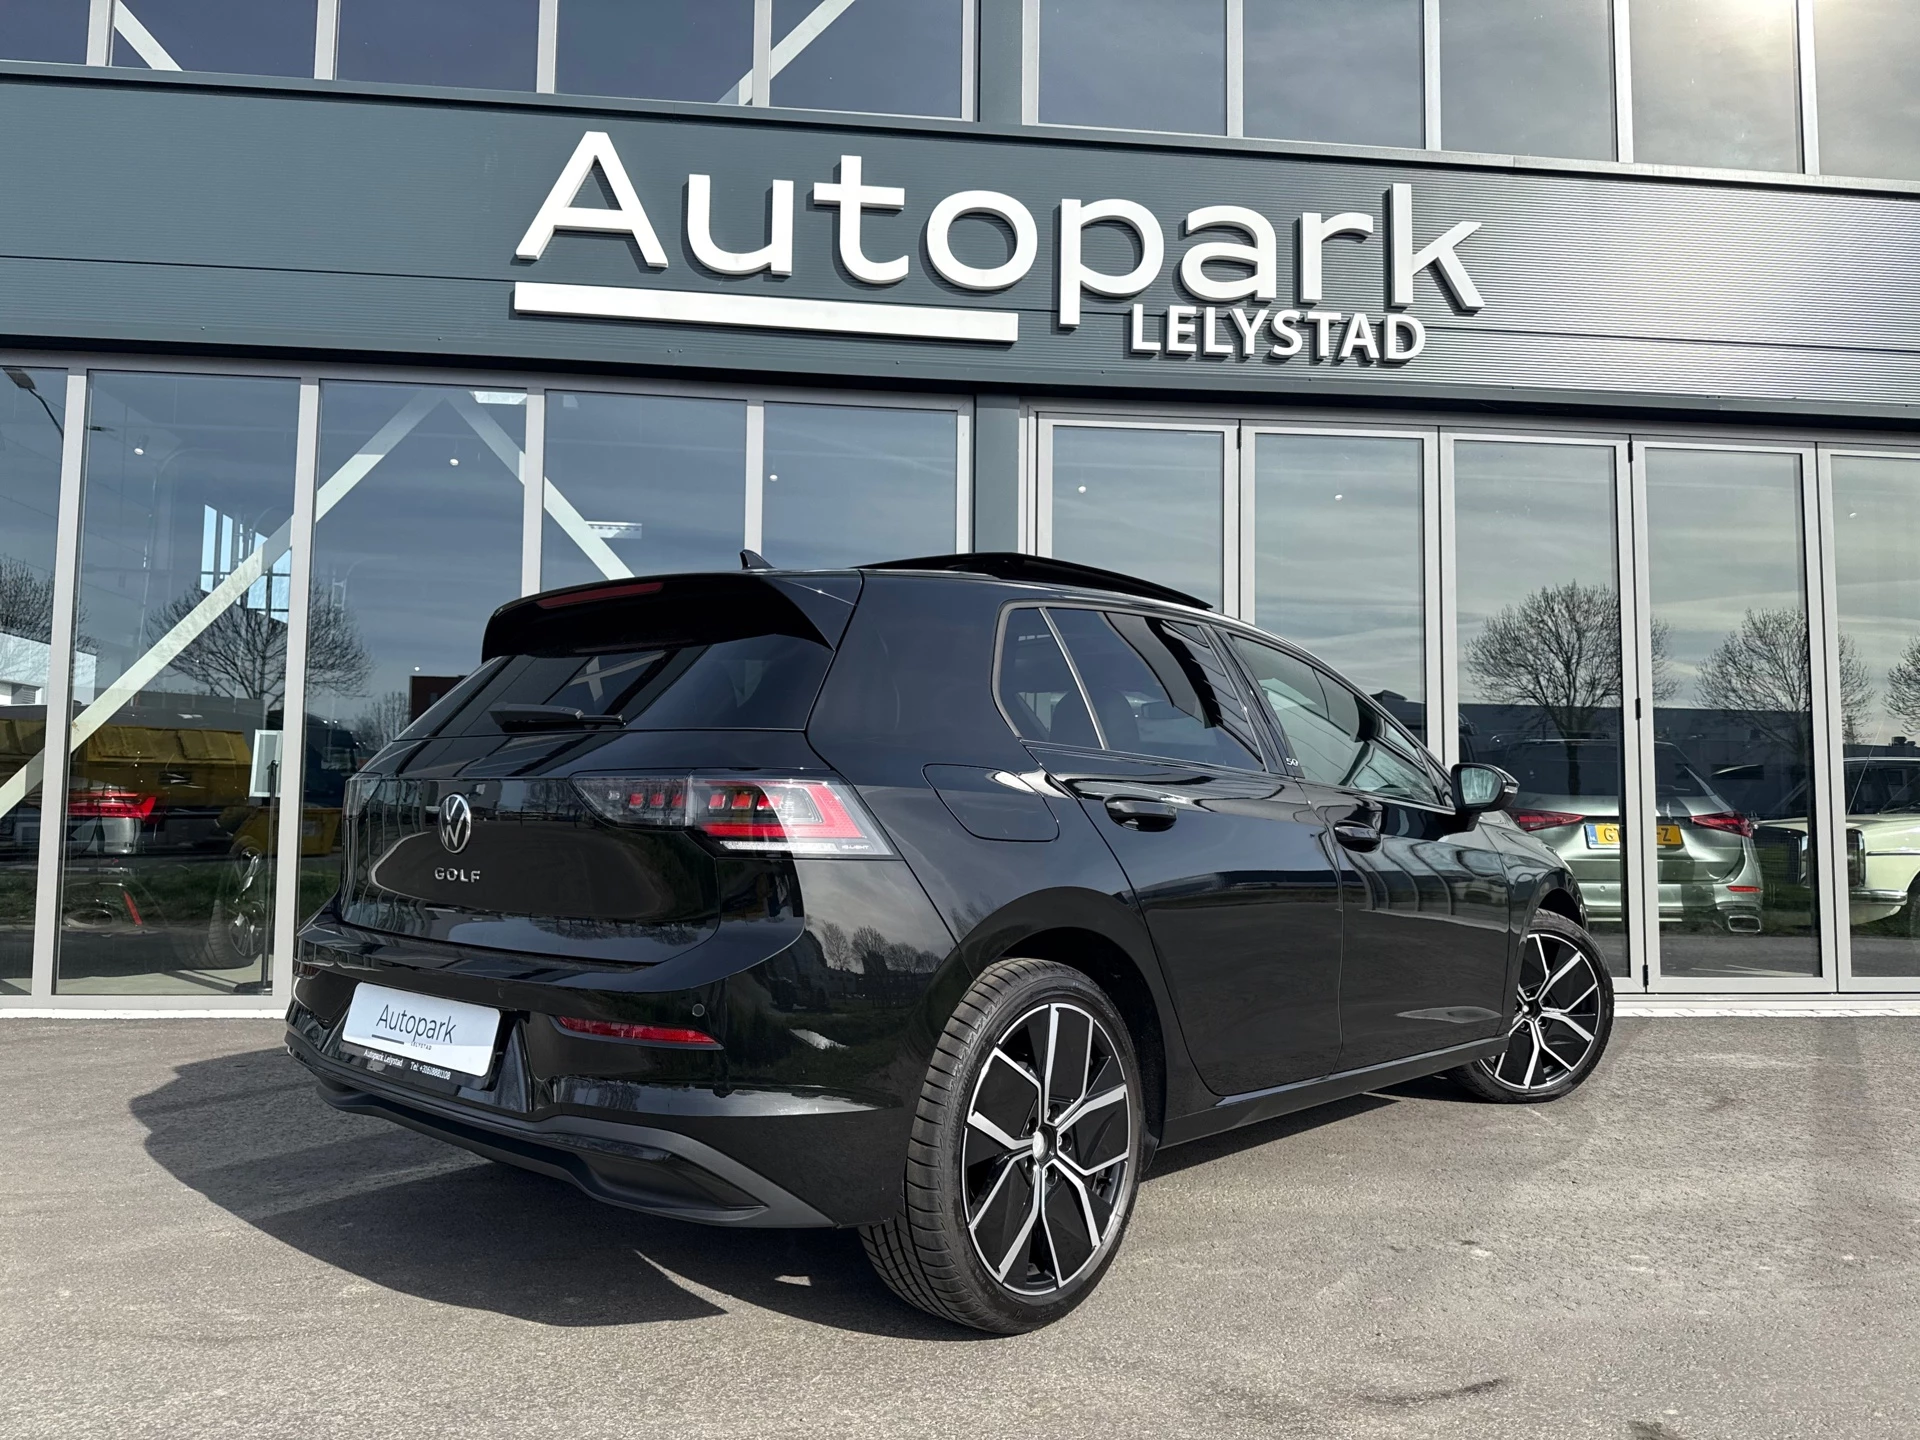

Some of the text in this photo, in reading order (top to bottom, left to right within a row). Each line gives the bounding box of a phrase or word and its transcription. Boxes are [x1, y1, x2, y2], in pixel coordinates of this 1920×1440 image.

[514, 131, 1485, 329] Autopark
[1129, 303, 1427, 364] LELYSTAD
[434, 867, 481, 883] GOLF
[376, 1004, 457, 1044] Autopark
[363, 1049, 384, 1061] Autopark
[384, 1053, 404, 1067] Lelystad
